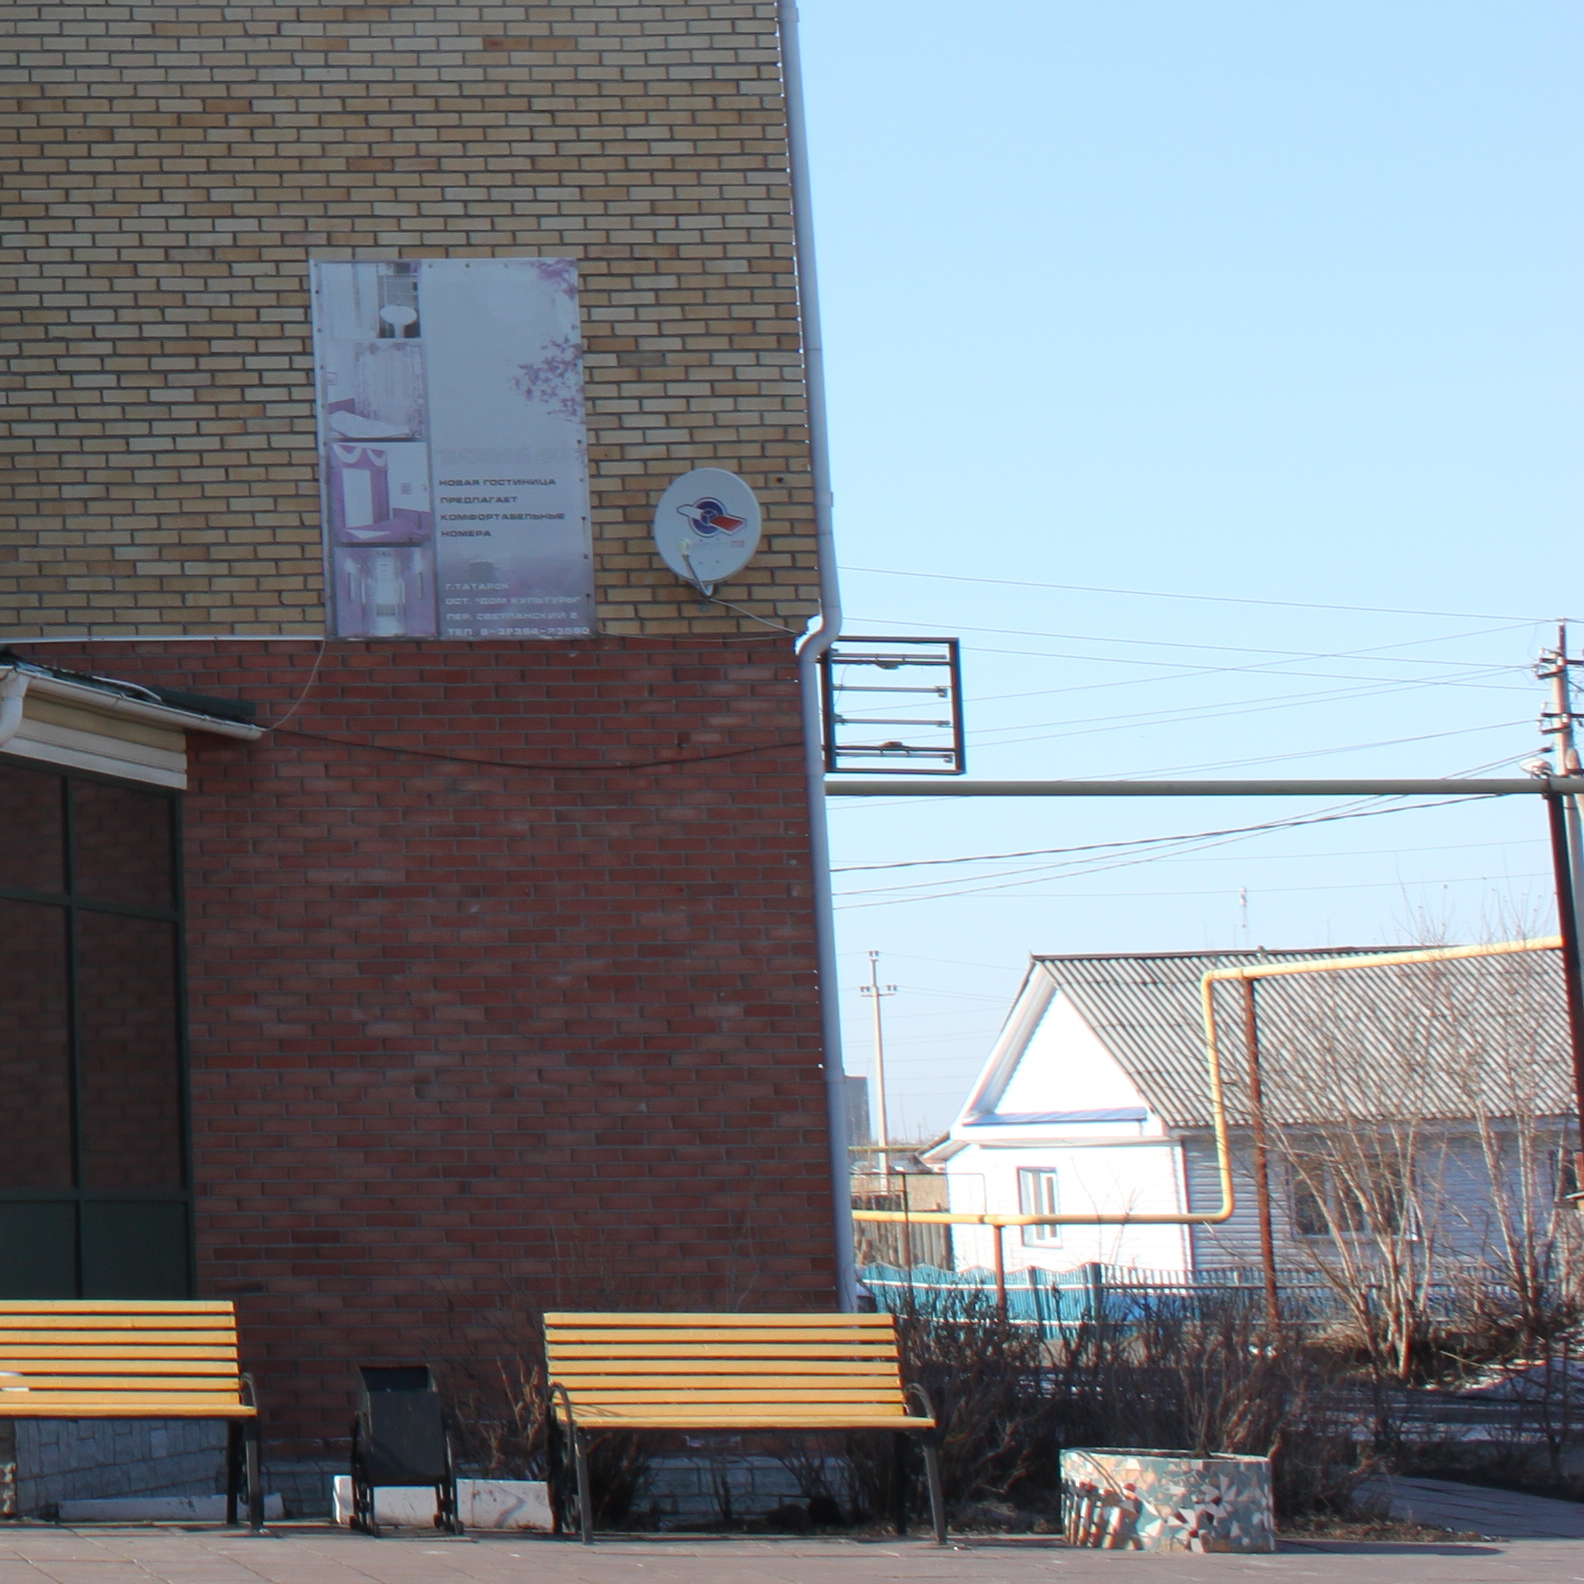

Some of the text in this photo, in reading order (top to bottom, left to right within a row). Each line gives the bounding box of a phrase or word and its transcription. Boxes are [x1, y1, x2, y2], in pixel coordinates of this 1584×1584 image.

[483, 478, 556, 486] ГОСТИНИЦА
[440, 496, 518, 504] ПРЕДЛАГАЕТ
[440, 513, 565, 521] КОМФОРТАБЕЛЬНЫЕ
[441, 530, 492, 538] НОМЕРА
